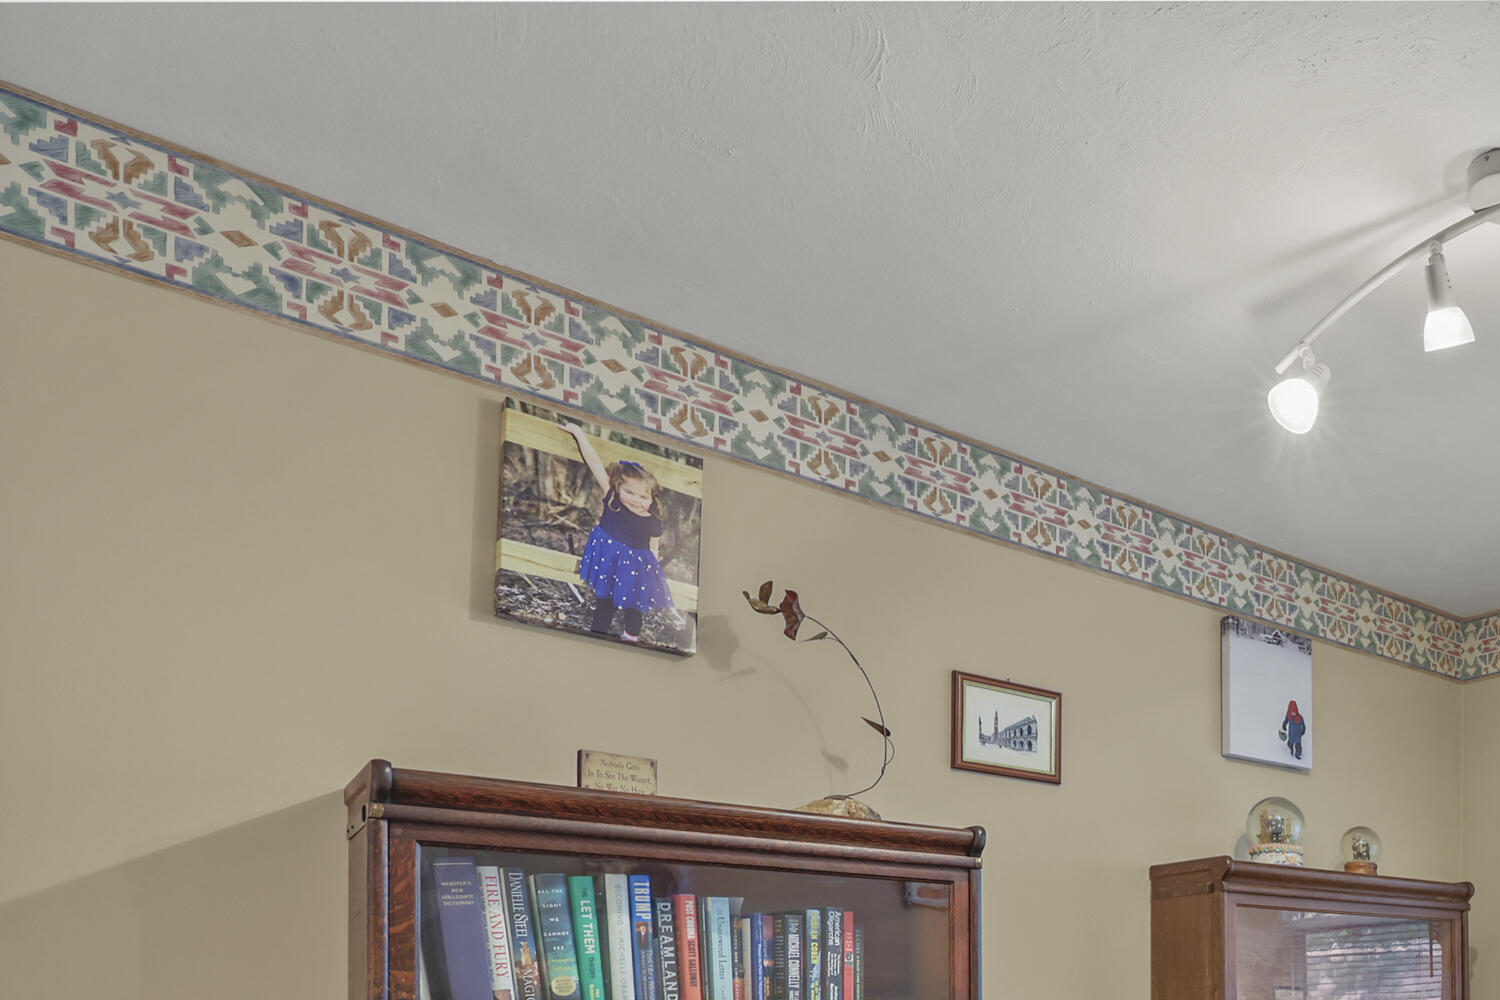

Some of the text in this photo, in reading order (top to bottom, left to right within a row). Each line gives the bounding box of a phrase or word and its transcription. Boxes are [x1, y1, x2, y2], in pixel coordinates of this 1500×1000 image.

[508, 872, 529, 938] DANIELLE STEEL
[580, 900, 592, 919] LET
[634, 881, 651, 920] TRUMP
[685, 900, 695, 915] POST
[485, 876, 510, 978] FIRE AND FURY
[582, 923, 596, 954] THEM
[687, 940, 696, 957] SCOTT
[788, 934, 800, 958] MICHAEL
[810, 942, 818, 964] COBEN
[788, 960, 800, 988] CONNELLY
